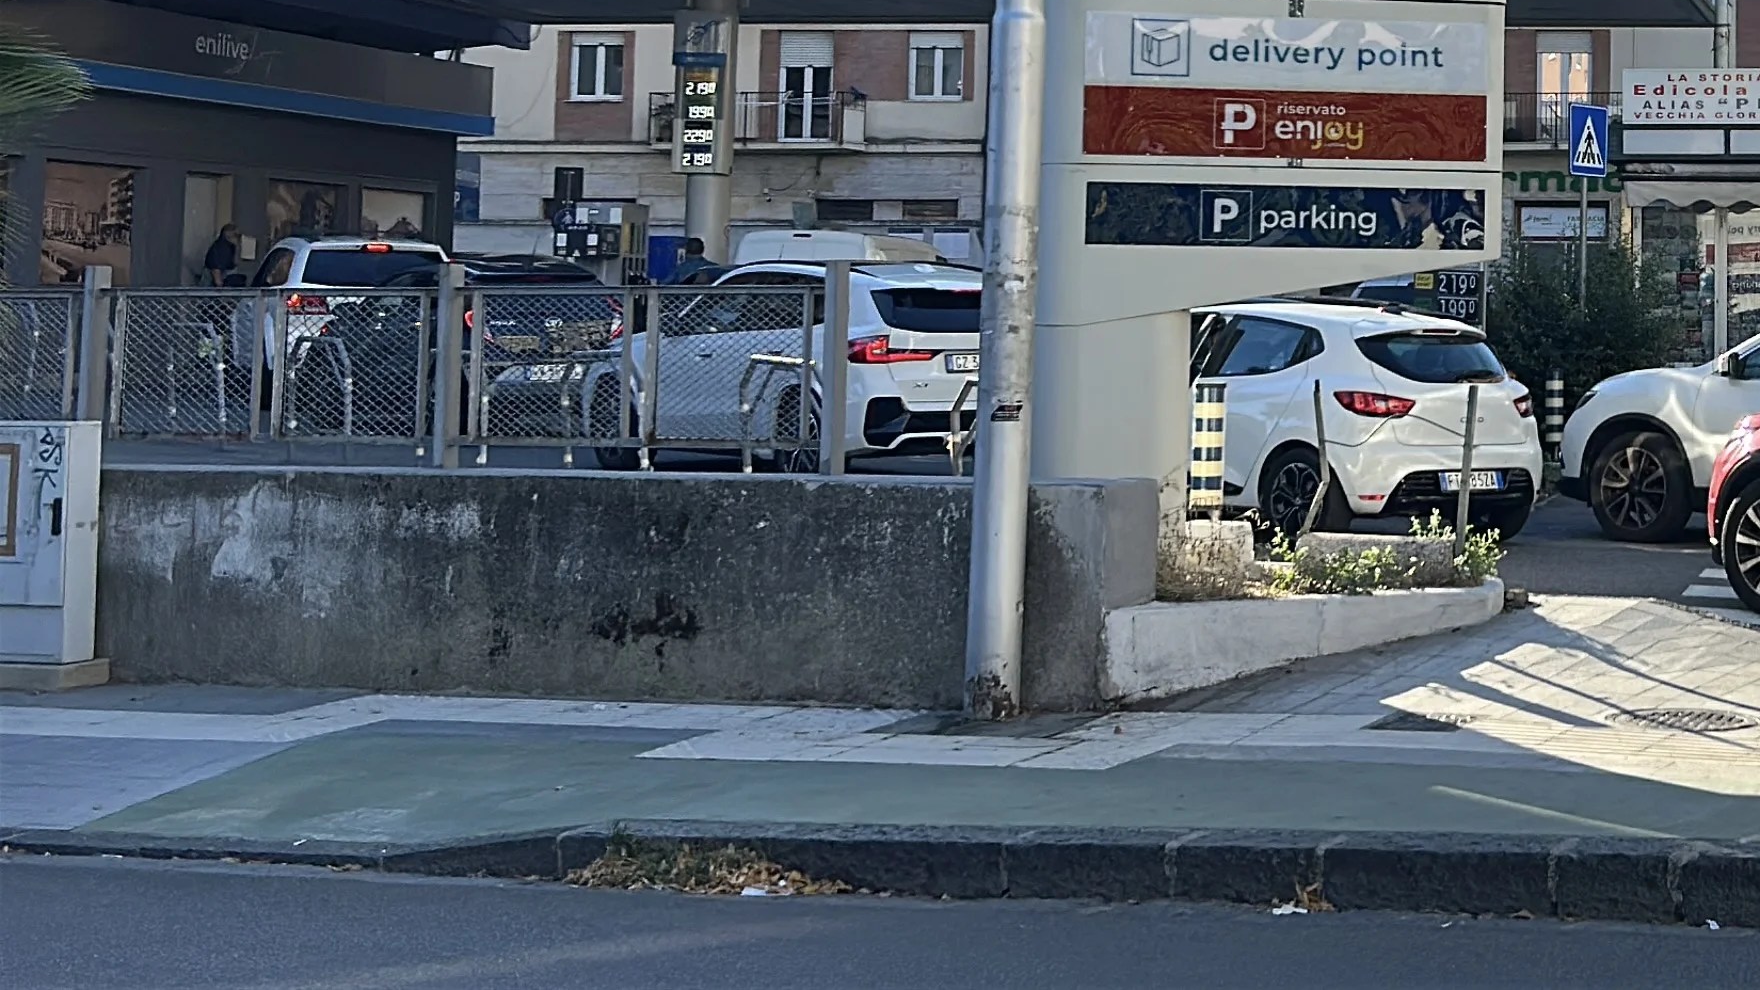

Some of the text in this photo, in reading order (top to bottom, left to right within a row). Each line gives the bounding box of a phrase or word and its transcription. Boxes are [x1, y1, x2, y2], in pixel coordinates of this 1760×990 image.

[195, 32, 249, 60] enilive
[1209, 38, 1444, 71] delivery point
[1667, 74, 1688, 82] LA
[1633, 84, 1747, 96] Edicola
[1276, 101, 1347, 116] riservato
[1642, 100, 1705, 110] ALIAS
[1274, 120, 1364, 150] enjoy
[1212, 197, 1378, 236] P parking
